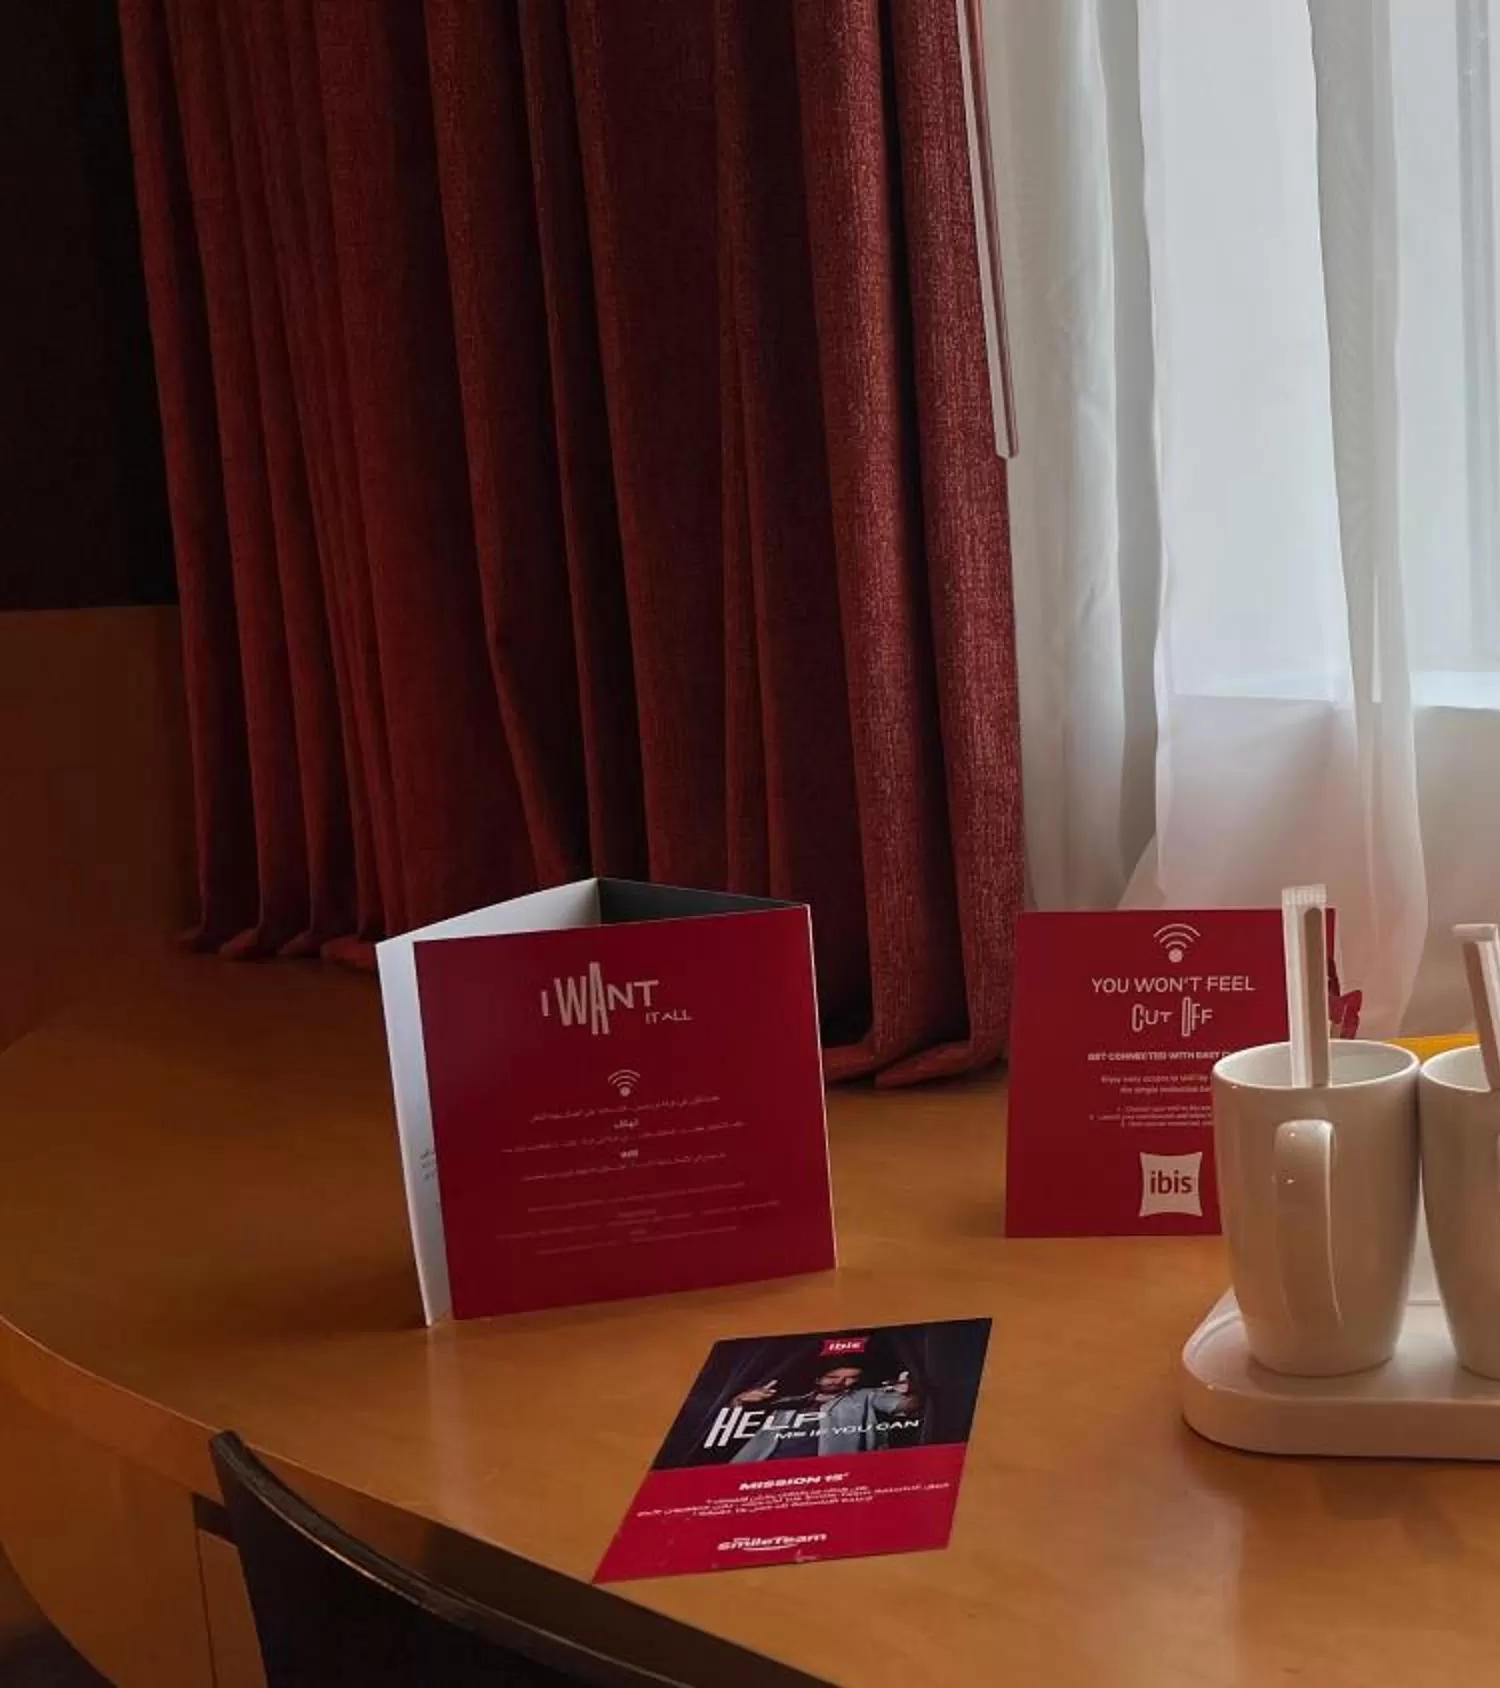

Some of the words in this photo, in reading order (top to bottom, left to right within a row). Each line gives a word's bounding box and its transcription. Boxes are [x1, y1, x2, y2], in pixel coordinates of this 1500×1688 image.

[1091, 977, 1130, 994] YOU
[1134, 976, 1203, 994] WON'T
[1207, 976, 1256, 992] FEEL
[540, 990, 550, 1017] I
[553, 961, 660, 1036] WANT
[645, 1011, 660, 1025] IT
[661, 1009, 694, 1021] ALL
[1169, 1051, 1195, 1060] WITH
[1151, 1170, 1193, 1194] ibis
[829, 1341, 861, 1351] ibis
[704, 1406, 827, 1448] HELP
[832, 1424, 871, 1434] YOU
[876, 1419, 920, 1431] CAN
[739, 1475, 821, 1490] MISSION
